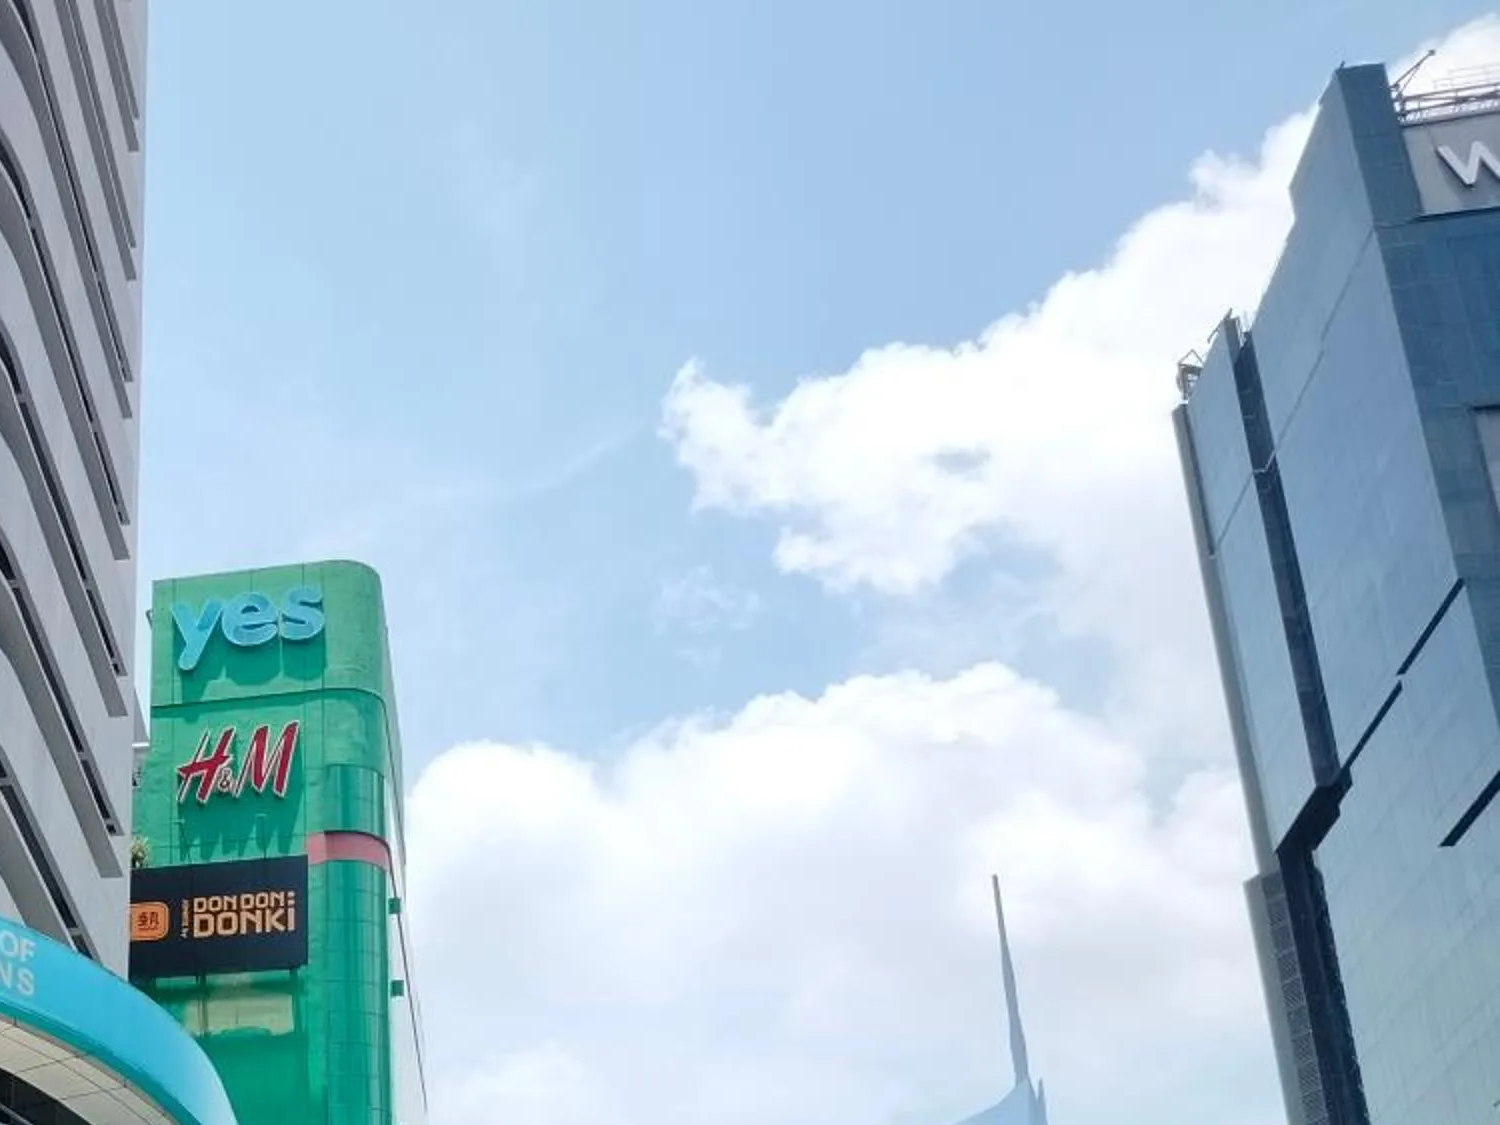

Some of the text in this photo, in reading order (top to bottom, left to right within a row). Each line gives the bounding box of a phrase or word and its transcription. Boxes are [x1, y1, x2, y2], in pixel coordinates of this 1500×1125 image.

[170, 584, 326, 672] yes
[175, 719, 301, 805] H&M
[193, 891, 285, 913] DON DON
